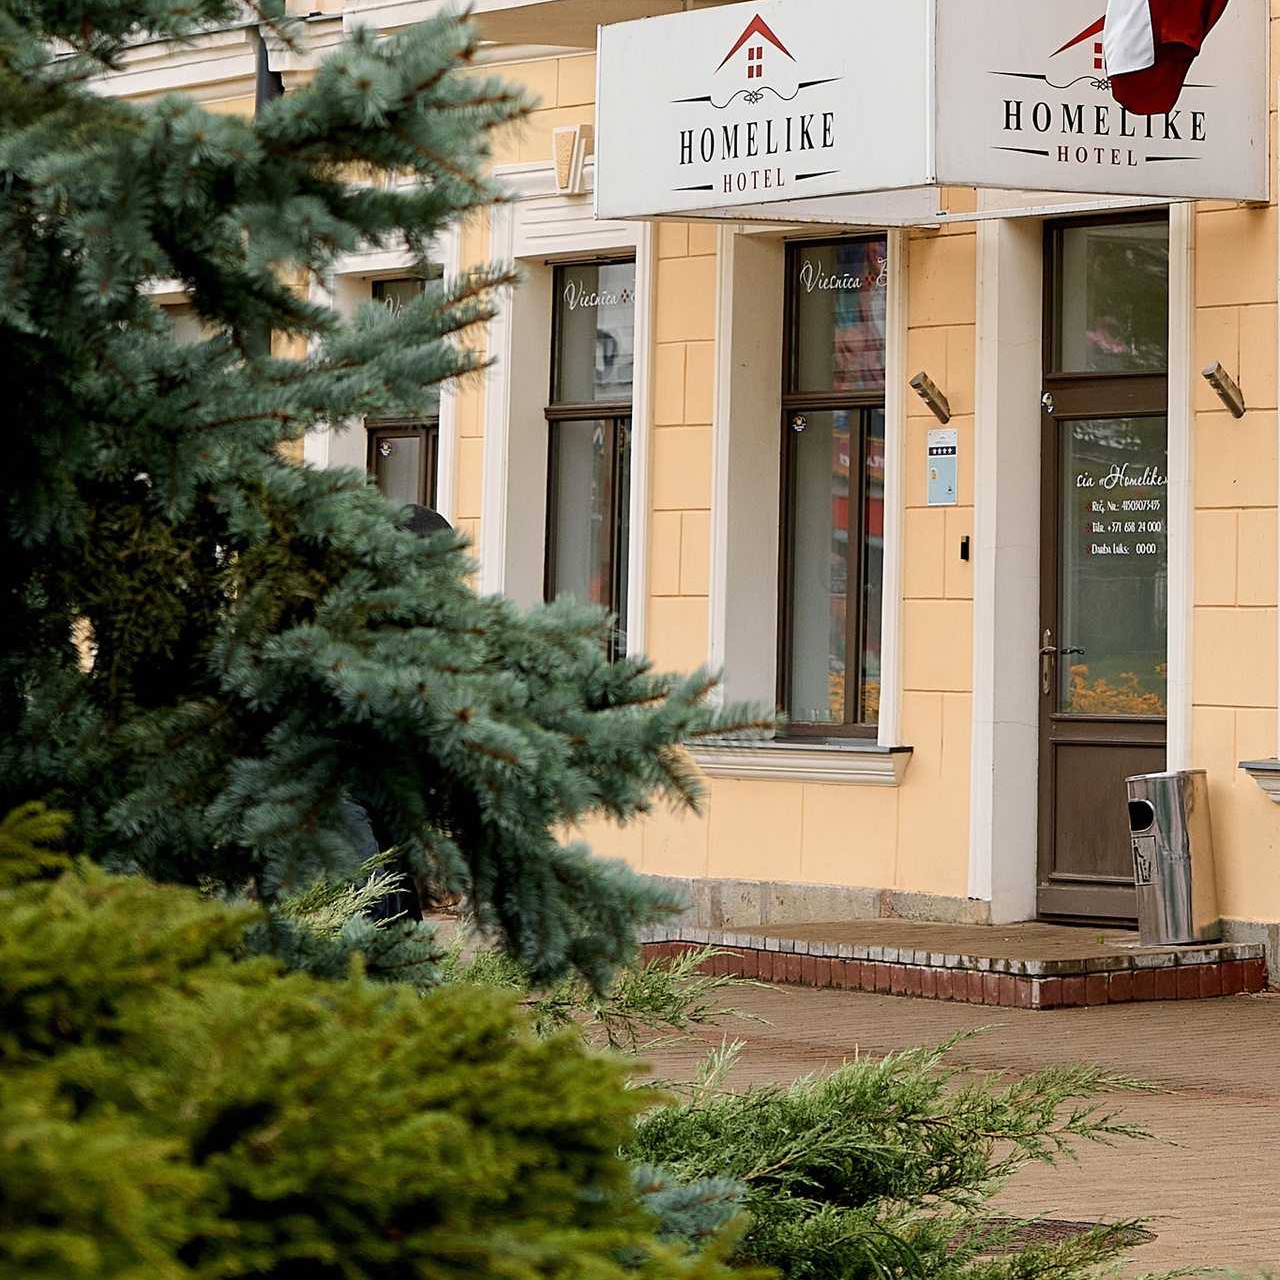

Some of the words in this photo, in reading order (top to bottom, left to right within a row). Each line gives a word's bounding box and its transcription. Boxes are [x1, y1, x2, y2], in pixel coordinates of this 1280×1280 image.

[1003, 100, 1207, 141] HOMELIKE
[679, 112, 835, 165] HOMELIKE
[1057, 145, 1138, 167] HOTEL
[723, 168, 786, 193] HOTEL
[799, 260, 863, 293] Viesnīca
[1147, 521, 1162, 532] 000
